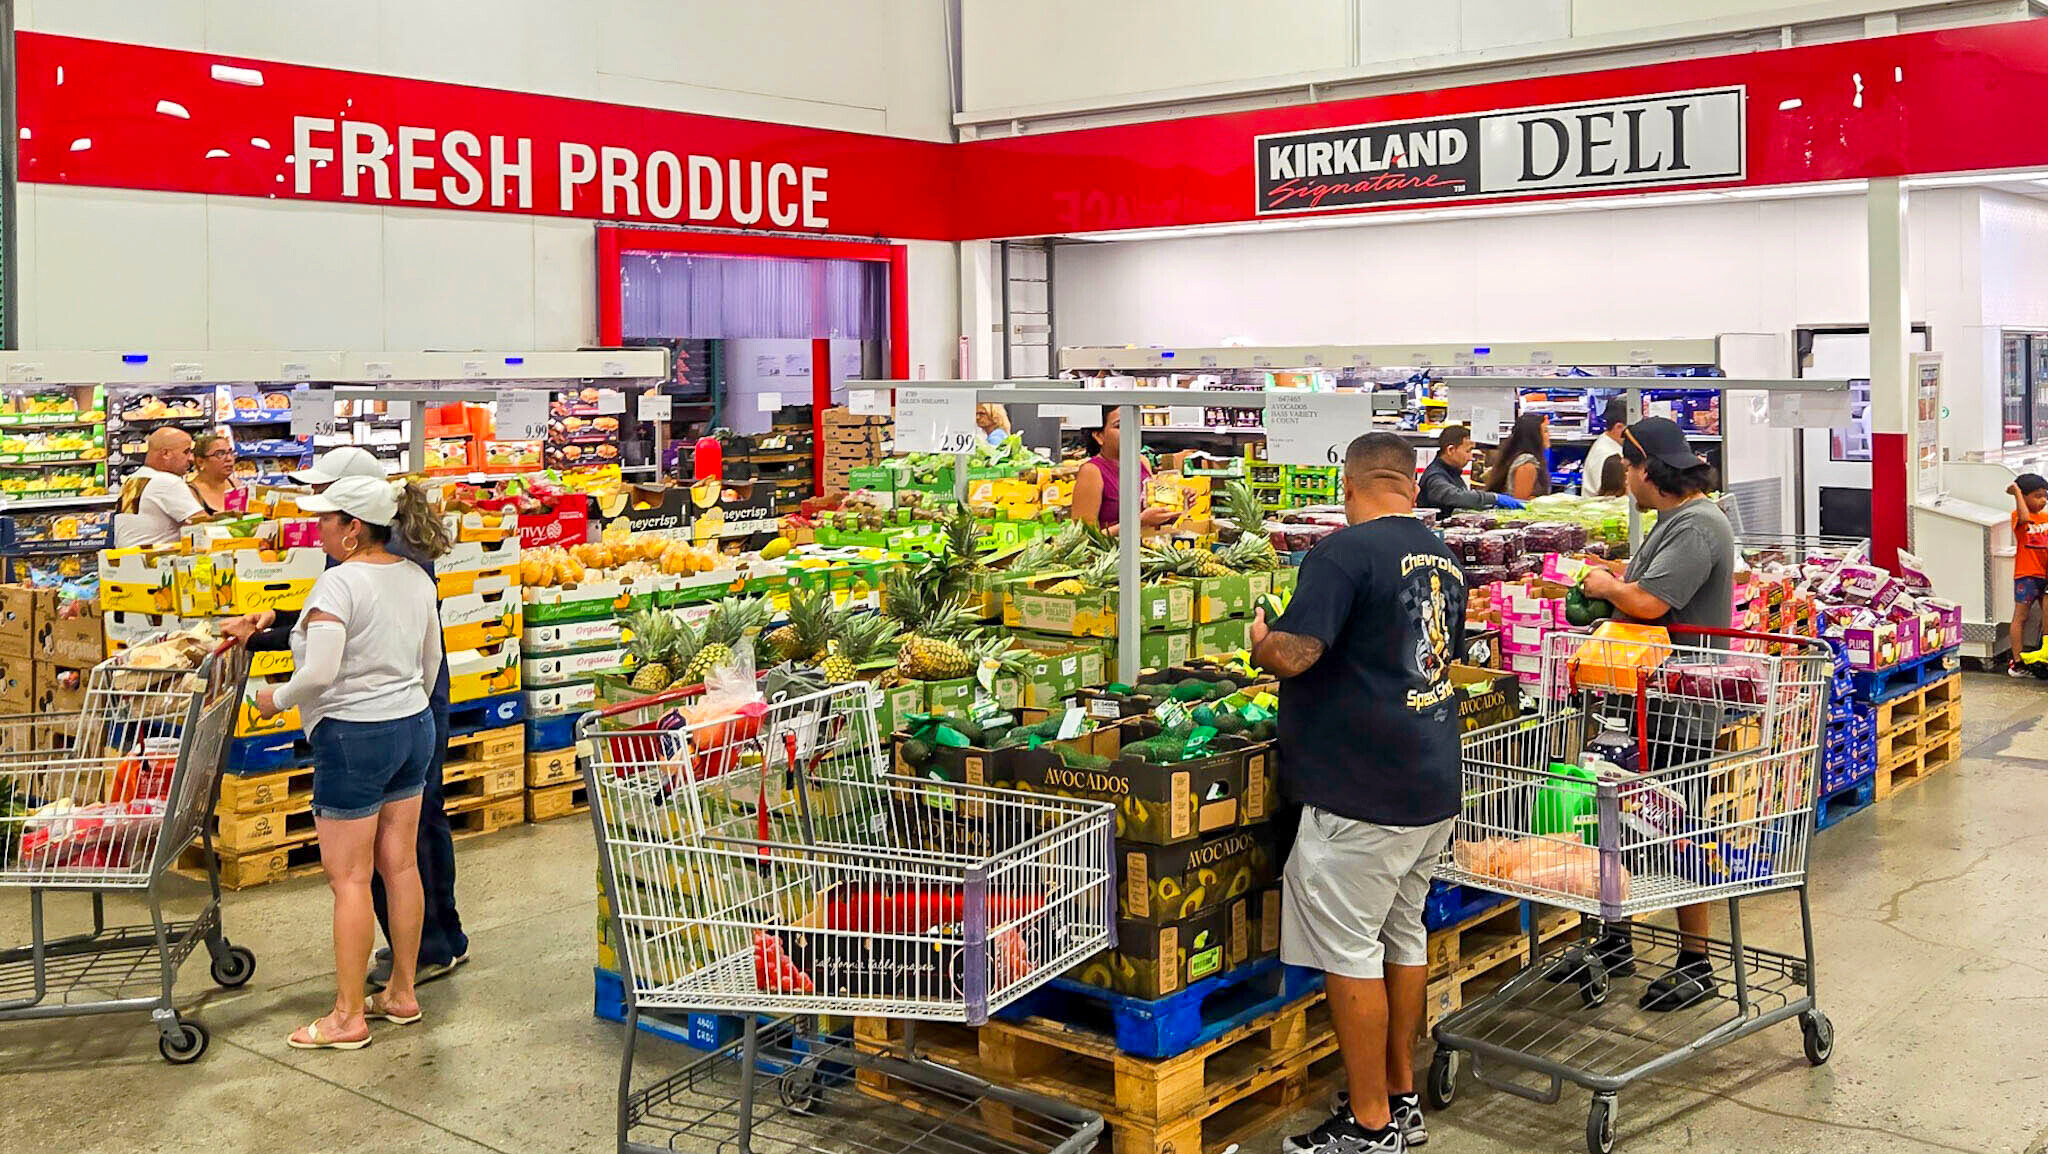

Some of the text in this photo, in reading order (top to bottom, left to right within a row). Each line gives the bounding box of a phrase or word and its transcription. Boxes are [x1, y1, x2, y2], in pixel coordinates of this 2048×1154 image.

[1269, 104, 1691, 182] KIRKLAND DELI
[294, 115, 829, 228] FRESH PRODUCE
[1267, 170, 1465, 208] Signature
[1289, 410, 1319, 418] VARIETY
[315, 422, 334, 435] 5.99
[525, 424, 547, 438] 9.99
[941, 434, 975, 452] 2.99
[723, 504, 768, 522] neycrisp
[629, 513, 678, 532] neycrisp
[734, 519, 776, 532] APPLES
[513, 524, 547, 546] envy
[575, 624, 614, 636] Organic
[1848, 638, 1870, 650] PLUMS
[576, 654, 617, 667] Organic
[1458, 690, 1506, 718] AVOCADOS
[1044, 768, 1130, 795] AVOCADOS
[1186, 832, 1256, 870] AVOCADOS
